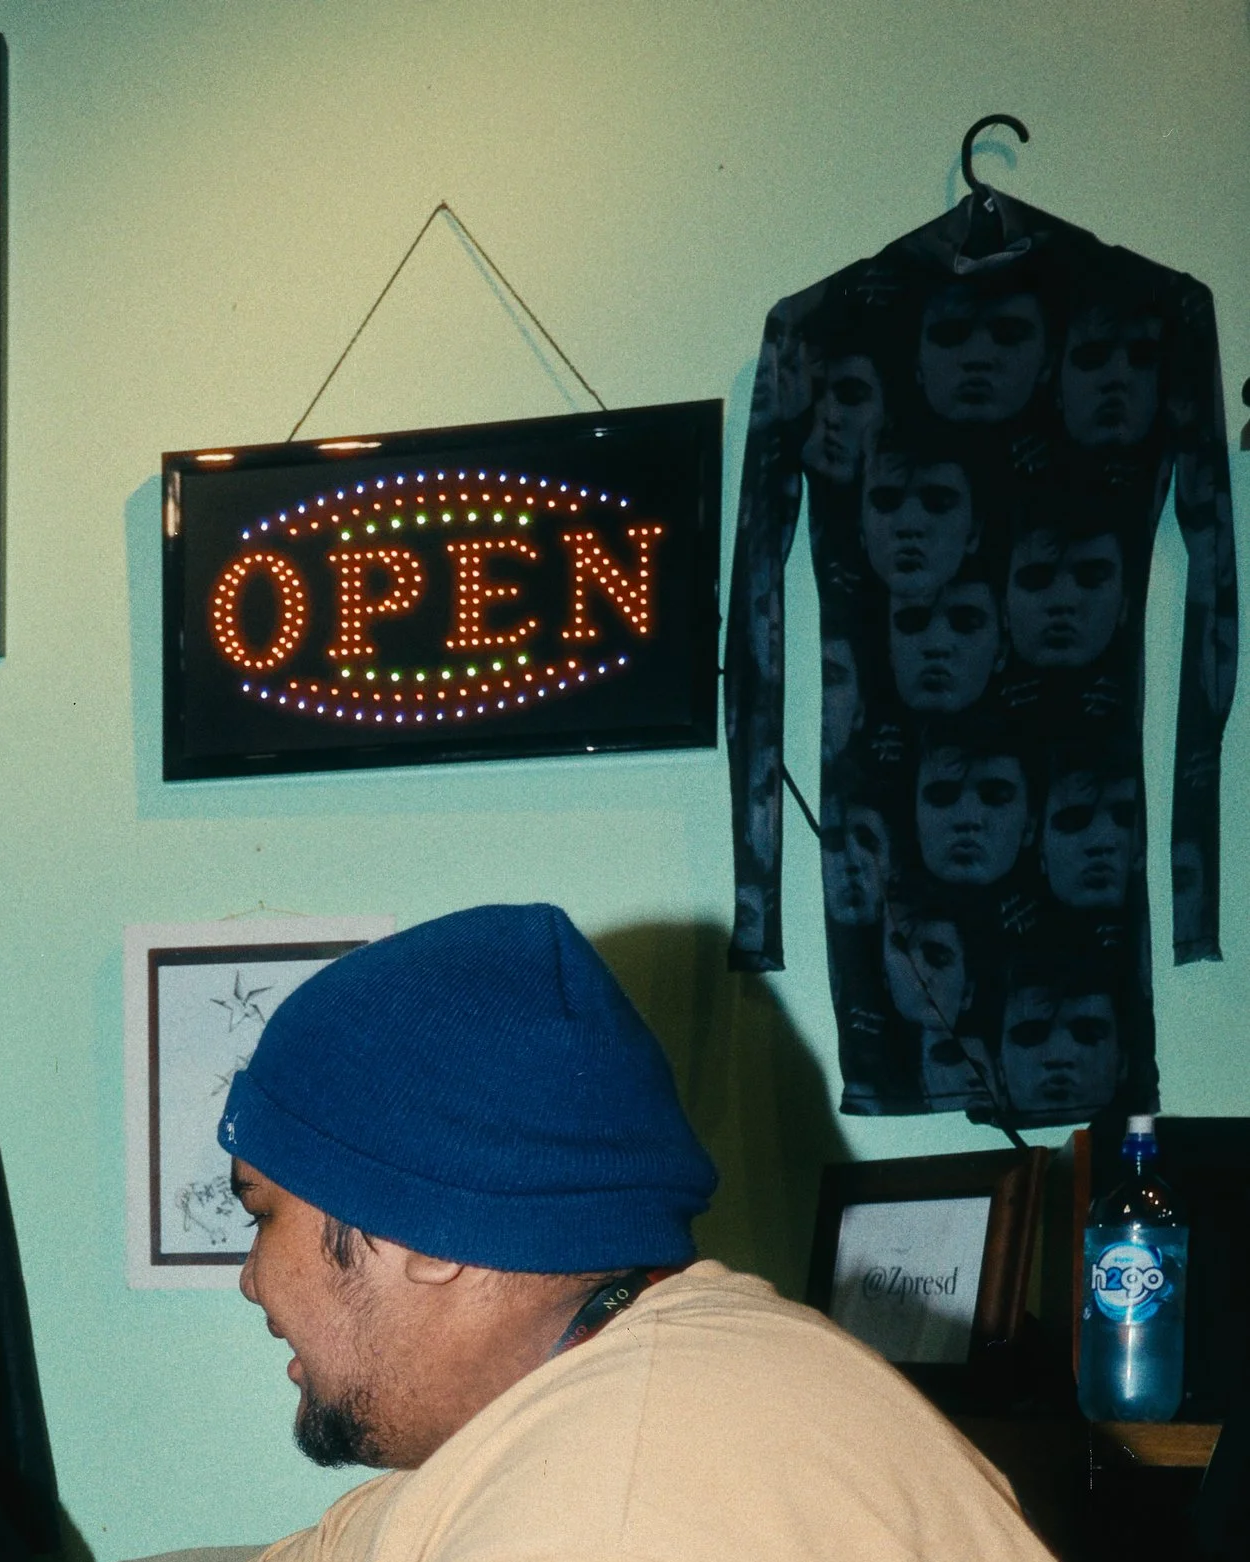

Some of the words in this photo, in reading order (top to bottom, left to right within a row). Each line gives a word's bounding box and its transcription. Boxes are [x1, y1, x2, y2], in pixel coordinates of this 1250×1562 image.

[208, 524, 665, 674] OPEN
[603, 1288, 629, 1310] NO
[863, 1266, 959, 1304] @Zpresd
